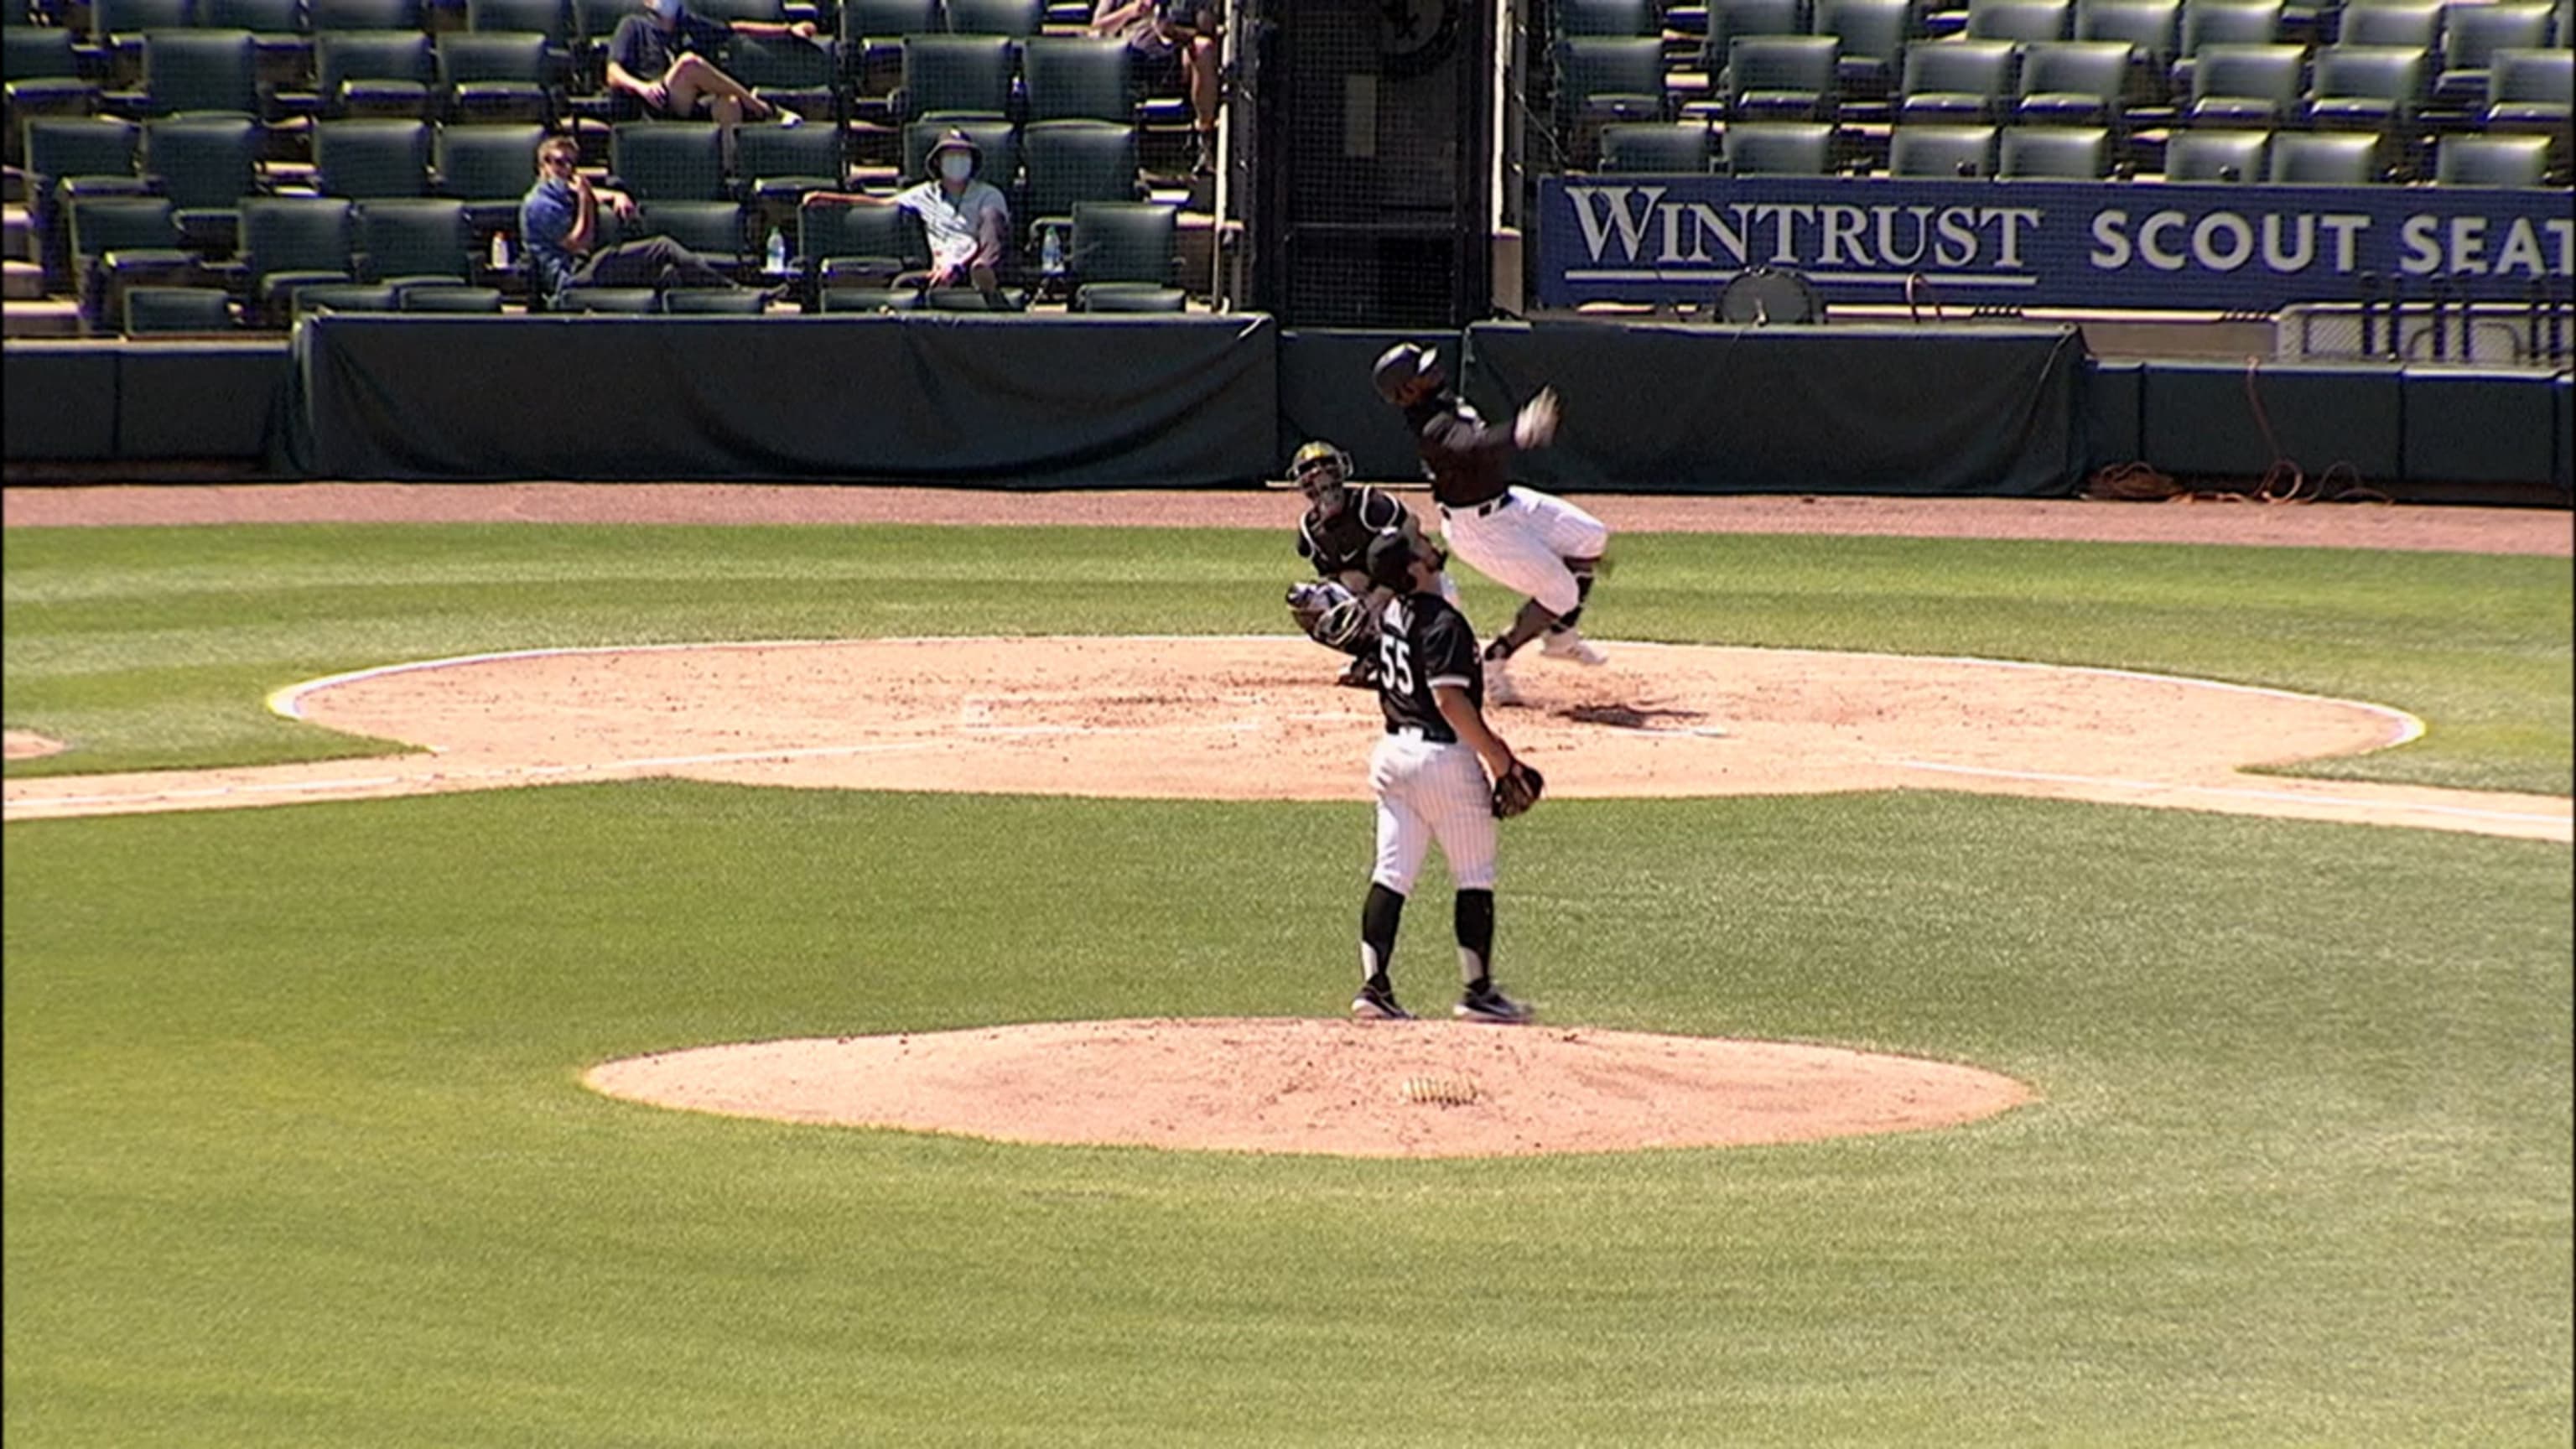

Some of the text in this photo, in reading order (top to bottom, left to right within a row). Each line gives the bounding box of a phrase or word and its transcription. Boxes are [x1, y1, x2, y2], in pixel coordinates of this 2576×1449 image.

[1565, 186, 2041, 267] WINTRUST
[2091, 210, 2371, 271] SCOUT
[1380, 633, 1414, 695] 55
